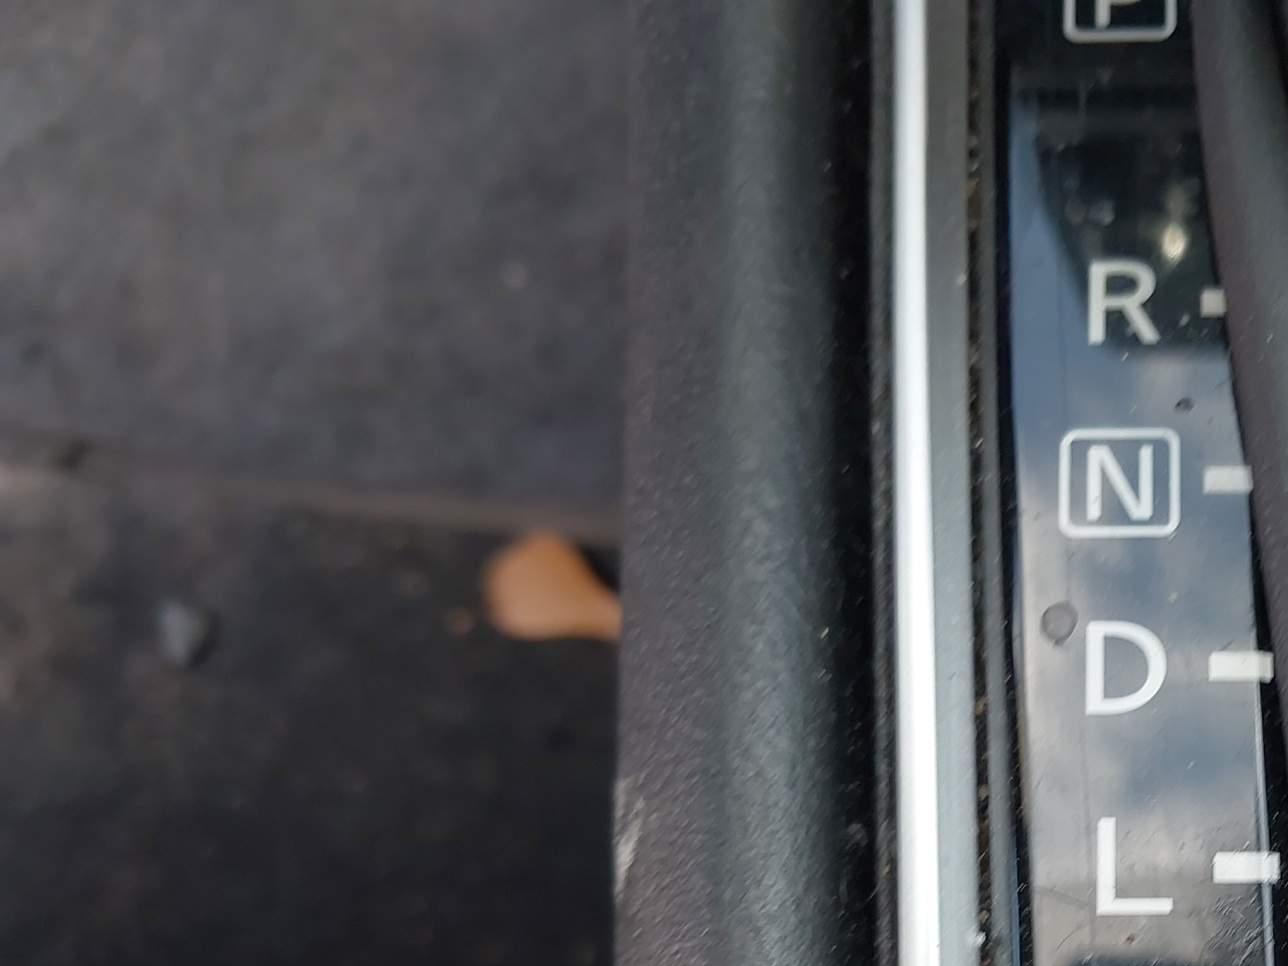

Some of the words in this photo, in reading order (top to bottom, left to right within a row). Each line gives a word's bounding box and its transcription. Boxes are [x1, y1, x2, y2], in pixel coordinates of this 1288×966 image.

[1088, 259, 1160, 345] R
[1086, 444, 1154, 521] N
[1085, 620, 1167, 716] D
[1096, 816, 1174, 916] L
